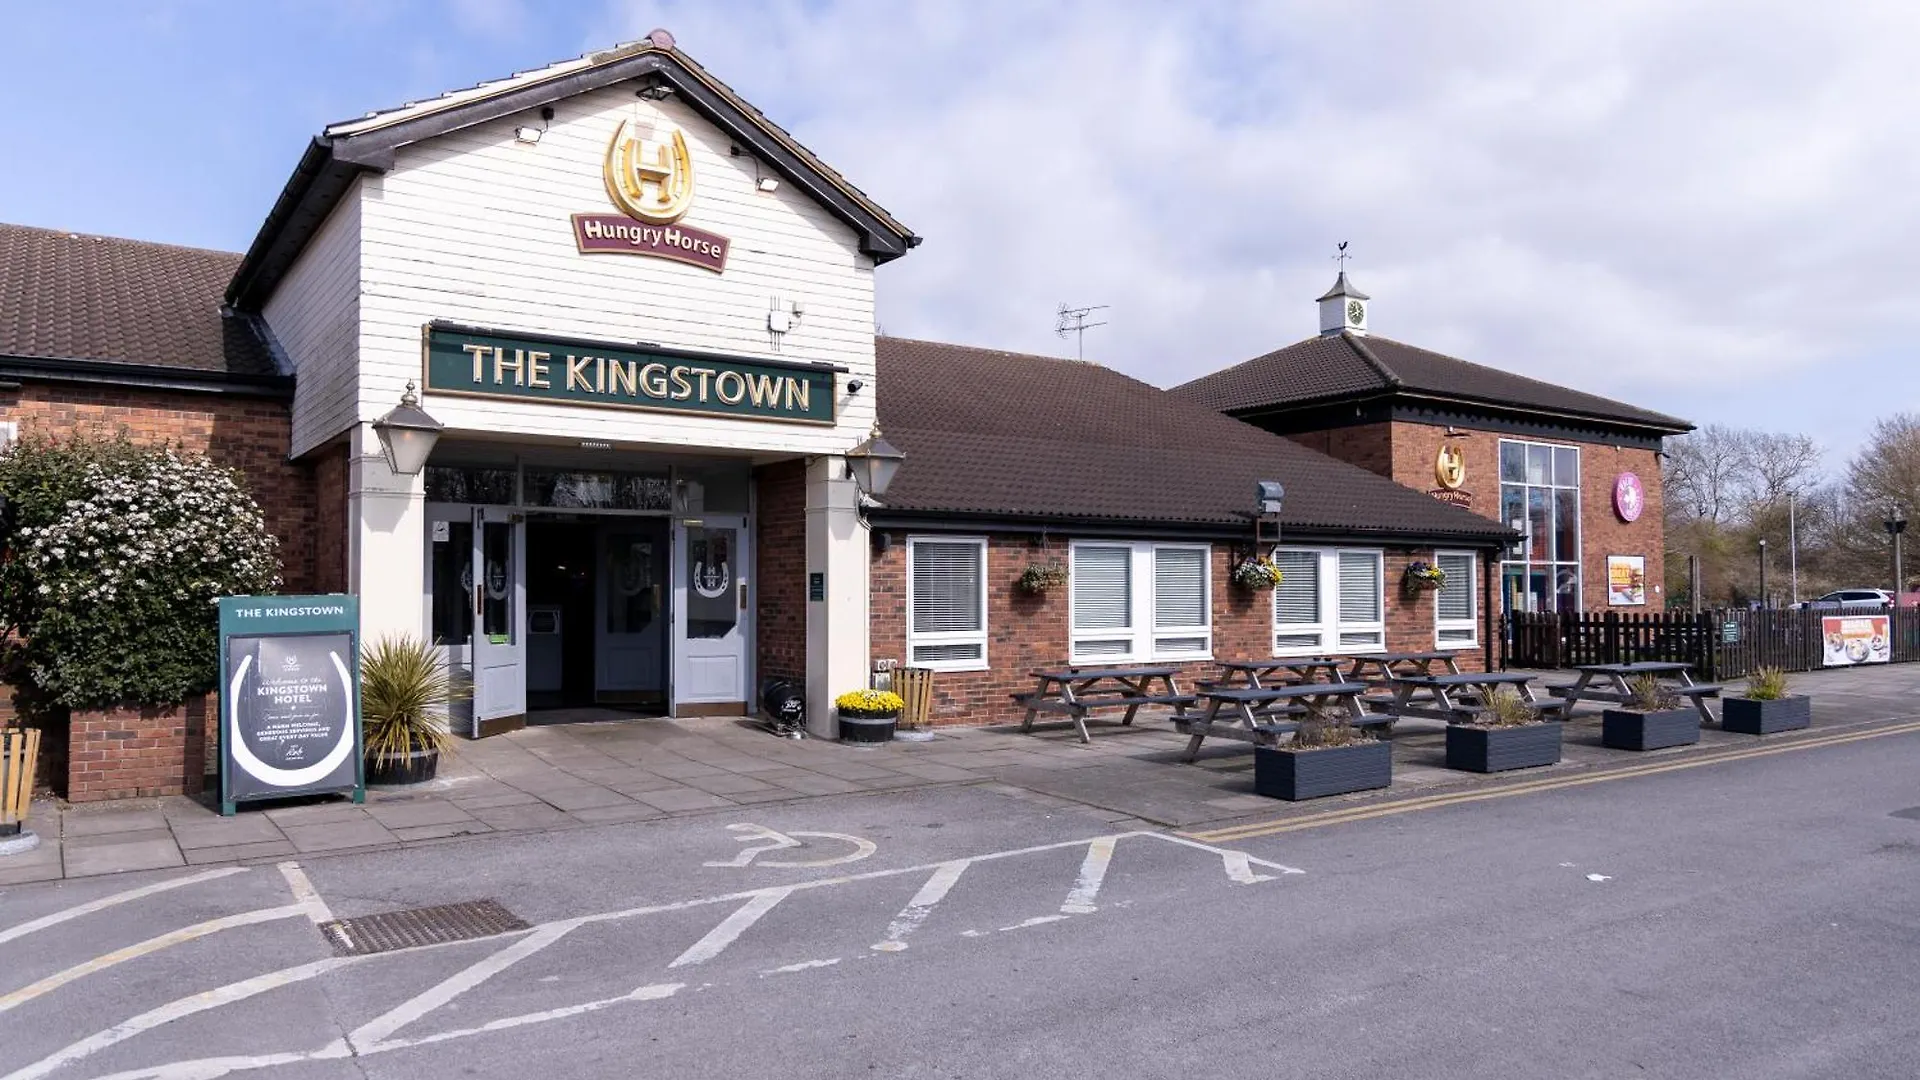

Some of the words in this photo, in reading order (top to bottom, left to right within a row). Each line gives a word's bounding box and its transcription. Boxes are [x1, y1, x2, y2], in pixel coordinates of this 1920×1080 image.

[583, 220, 662, 247] Hungry
[664, 228, 722, 258] Horse
[463, 343, 552, 389] THE
[566, 354, 811, 413] KINGSTOWN
[235, 608, 262, 618] THE
[266, 606, 344, 617] KINGSTOWN
[257, 684, 327, 696] KINGSTOWN
[274, 694, 313, 705] HOTEL
